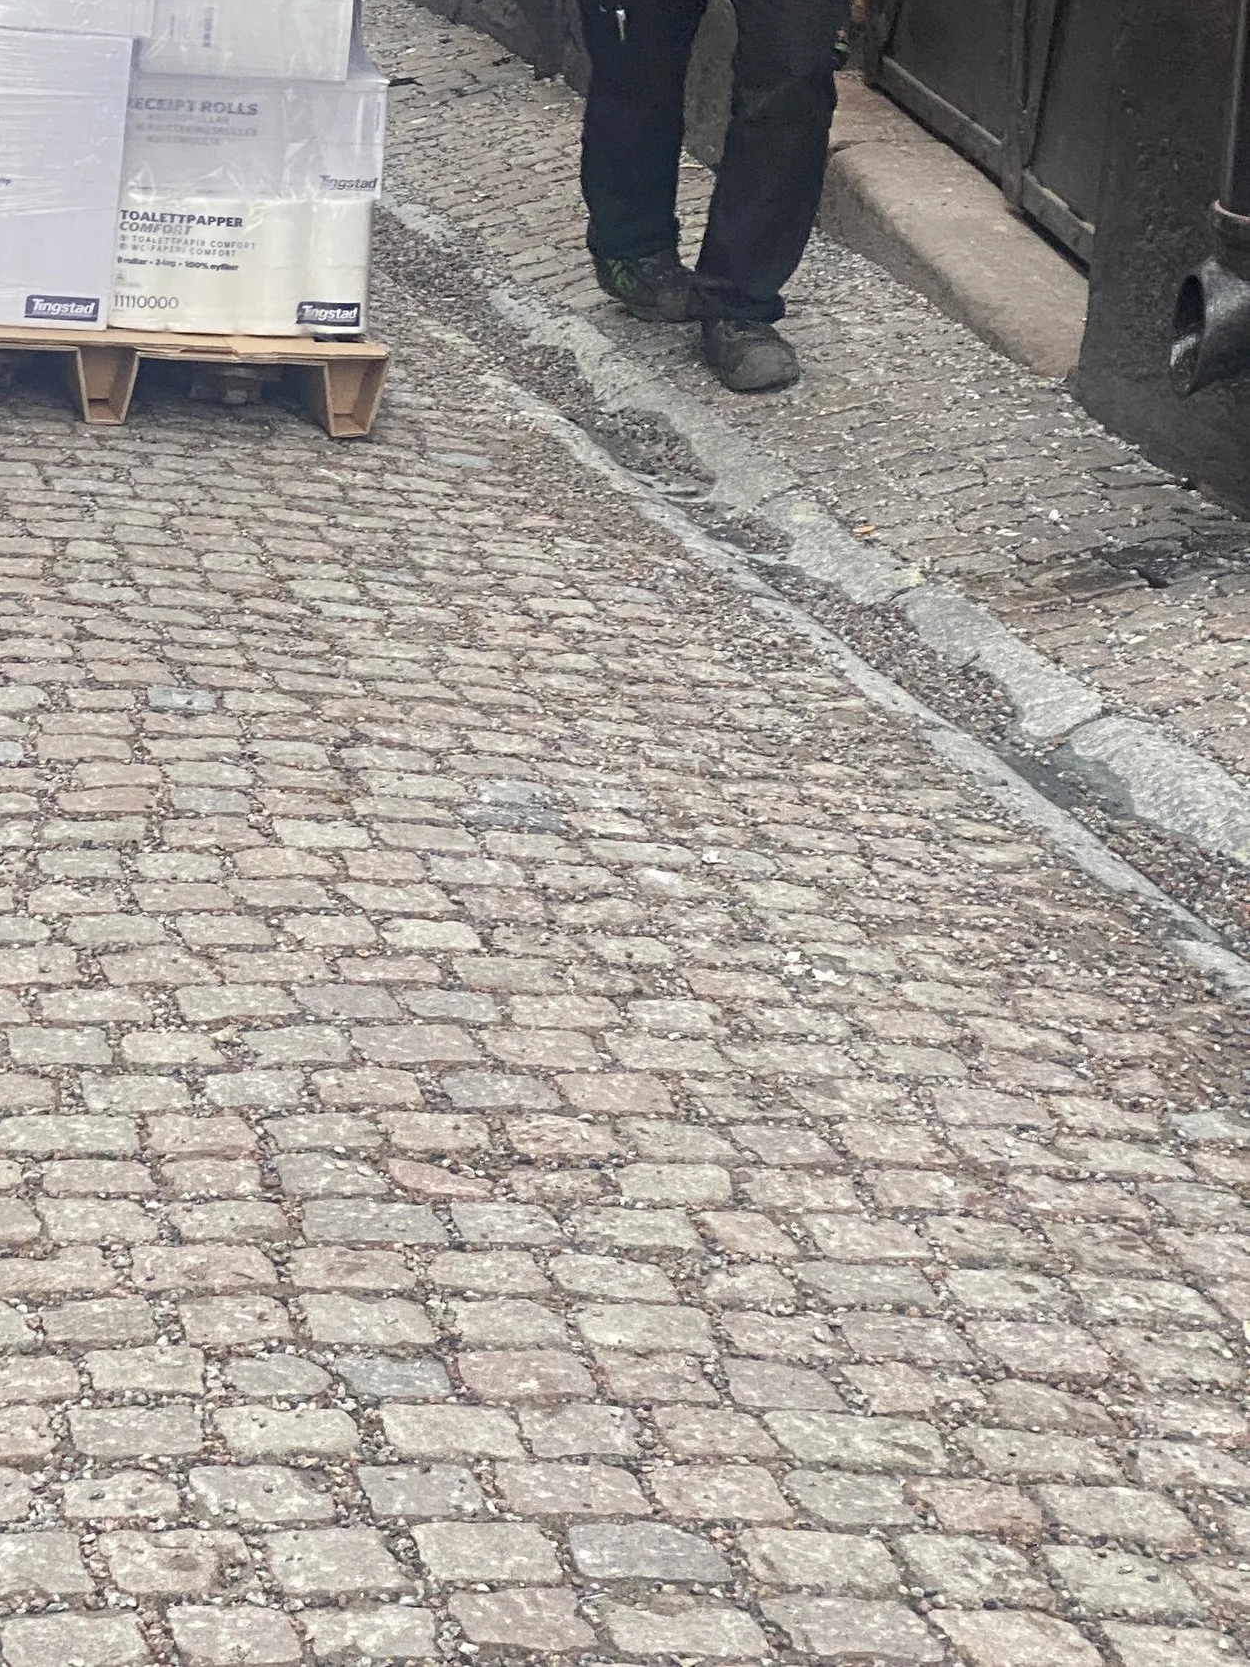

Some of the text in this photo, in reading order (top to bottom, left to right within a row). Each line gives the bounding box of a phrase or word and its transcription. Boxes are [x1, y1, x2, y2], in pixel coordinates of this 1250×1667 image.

[199, 100, 259, 116] ROLLS
[120, 209, 244, 227] TOALETTPAPPER
[119, 221, 193, 235] COMFORT
[32, 297, 96, 315] Tingstad
[114, 294, 179, 309] 11110000
